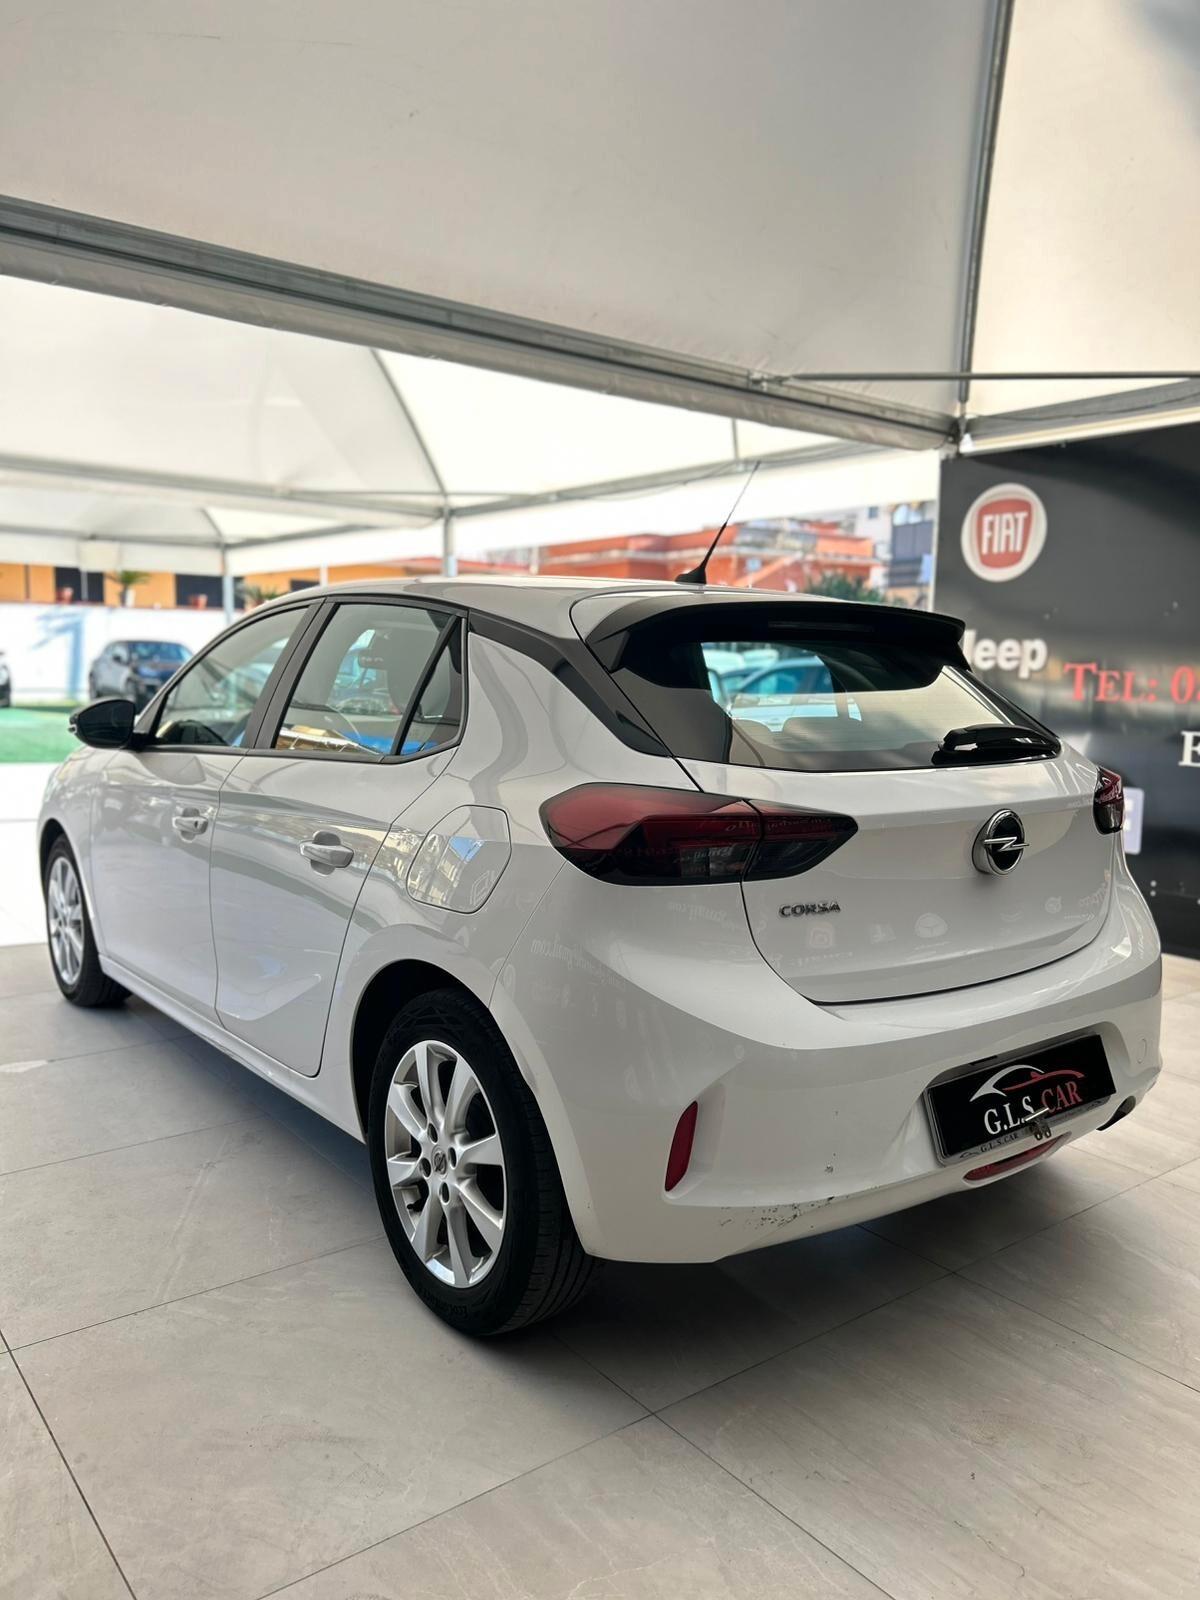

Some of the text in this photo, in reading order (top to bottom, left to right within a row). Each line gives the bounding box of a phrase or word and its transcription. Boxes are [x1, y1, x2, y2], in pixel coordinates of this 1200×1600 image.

[981, 512, 1028, 554] FIAT
[1170, 666, 1200, 704] 0
[779, 901, 841, 918] CORSA
[1041, 1081, 1083, 1114] CAR
